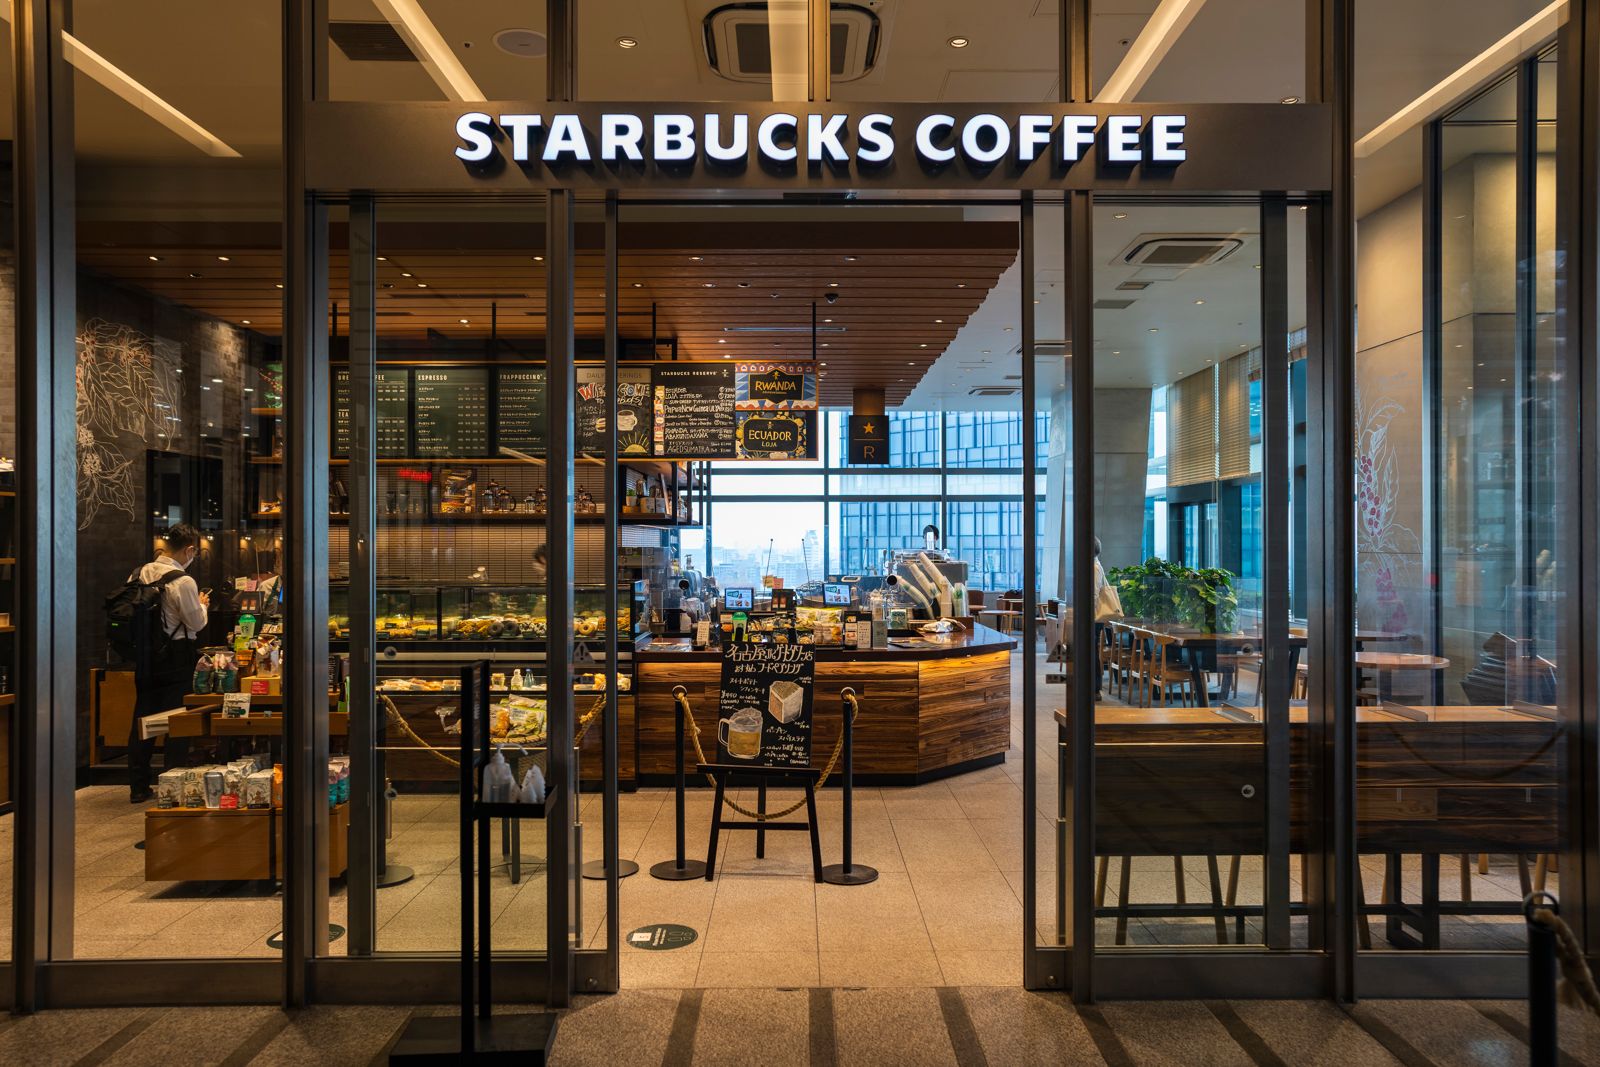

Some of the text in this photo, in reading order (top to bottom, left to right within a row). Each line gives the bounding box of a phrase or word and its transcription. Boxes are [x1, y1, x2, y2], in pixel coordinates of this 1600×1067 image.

[454, 112, 1187, 163] STARBUCKS COFFEE
[755, 381, 796, 391] RWANDA
[748, 430, 791, 441] ECUADOR
[863, 445, 875, 459] R
